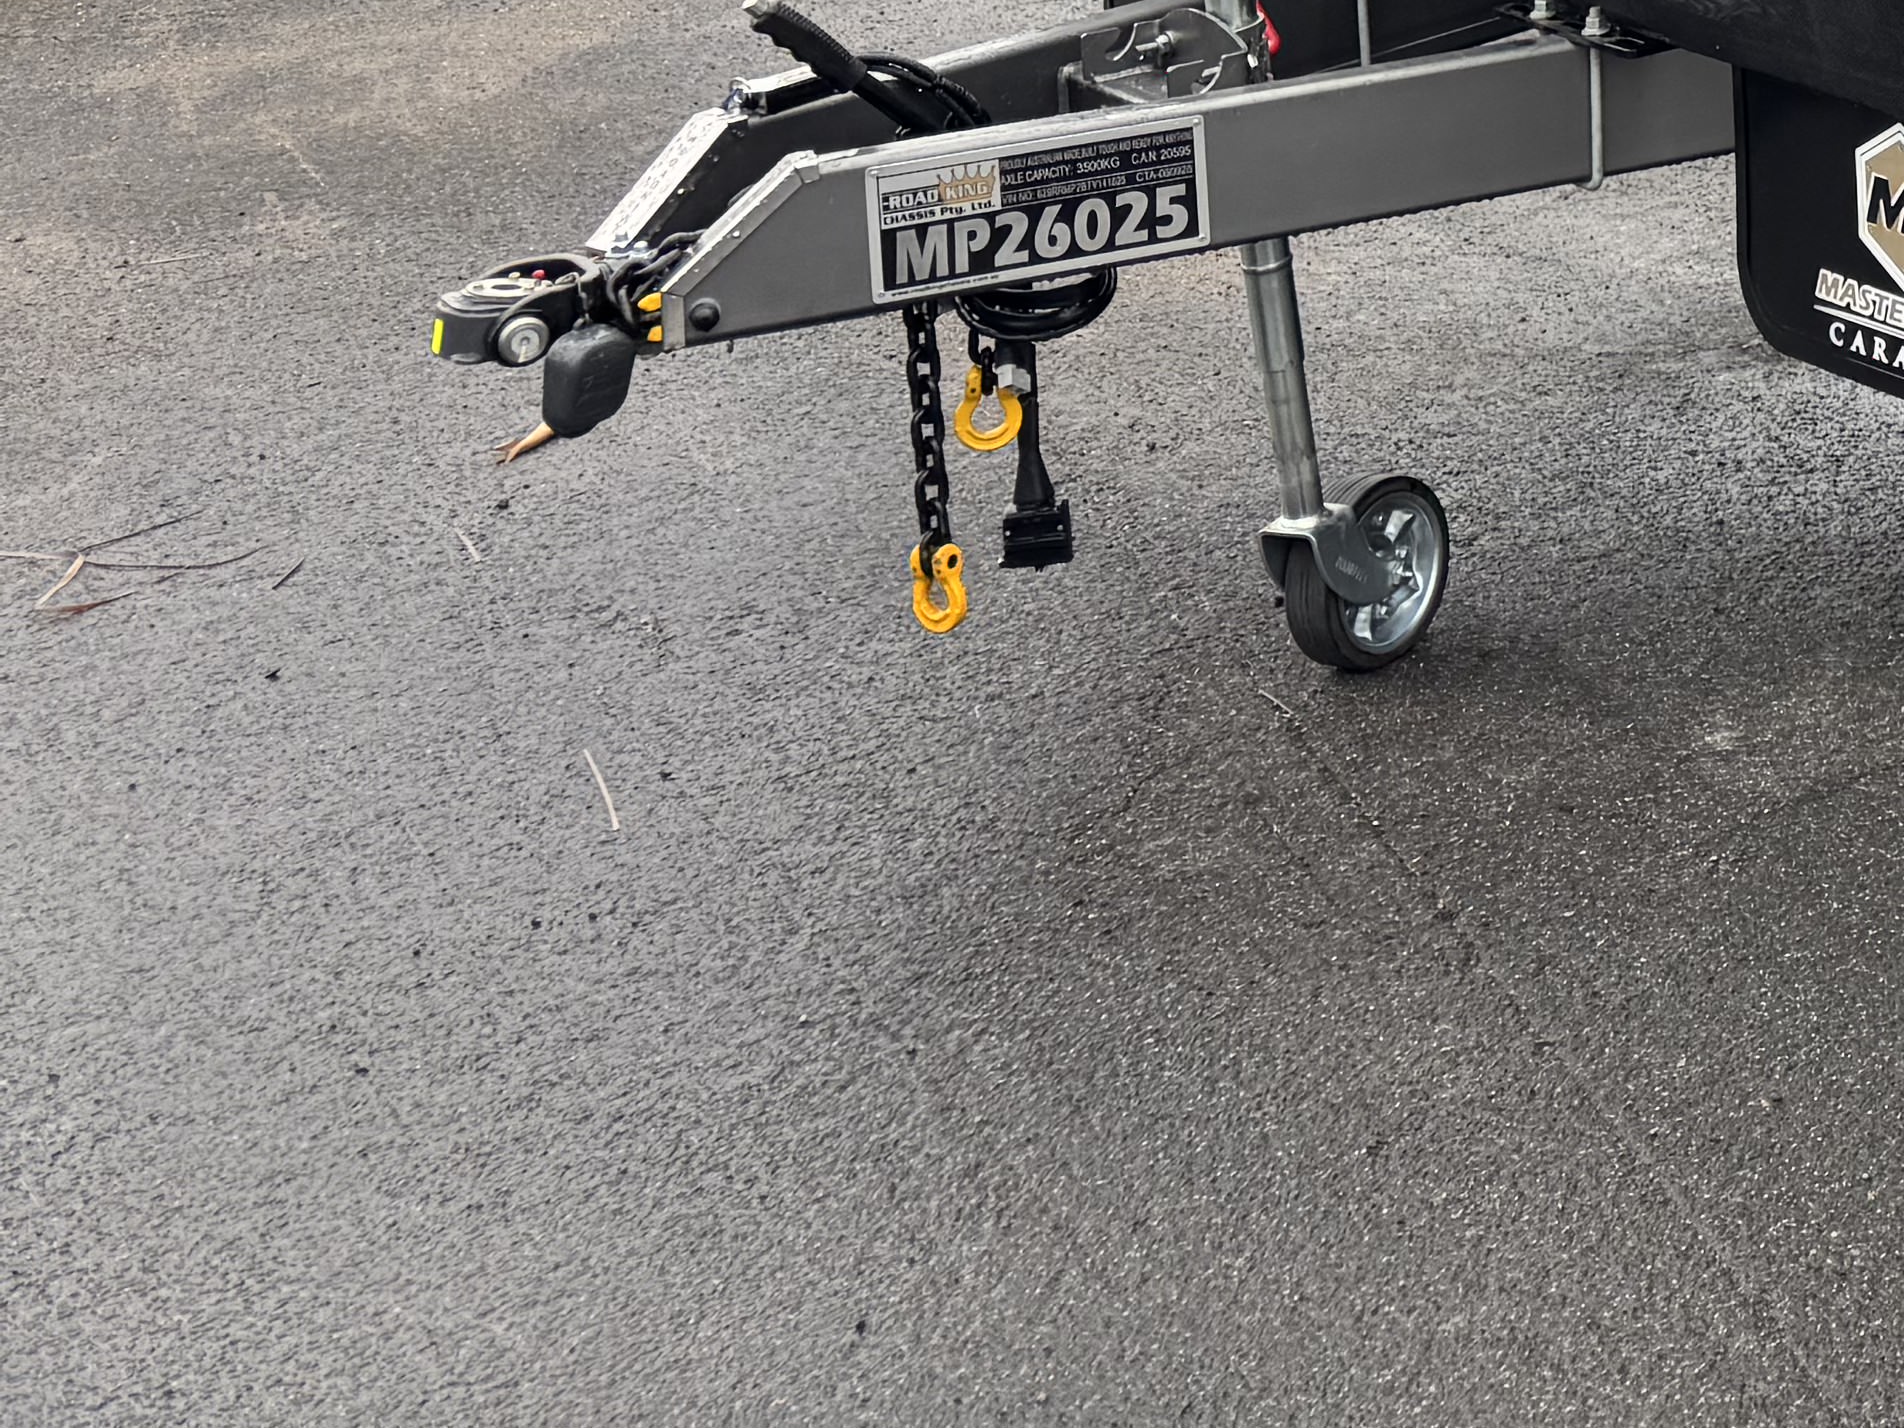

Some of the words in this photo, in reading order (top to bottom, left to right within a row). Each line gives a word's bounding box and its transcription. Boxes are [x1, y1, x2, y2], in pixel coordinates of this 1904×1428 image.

[1076, 156, 1120, 174] 3500KG
[888, 188, 939, 210] ROAD
[944, 181, 988, 201] KING
[883, 208, 936, 226] CHASSIS
[940, 205, 966, 218] Pty.
[971, 200, 996, 212] Ltd.
[895, 183, 1189, 285] MP26025
